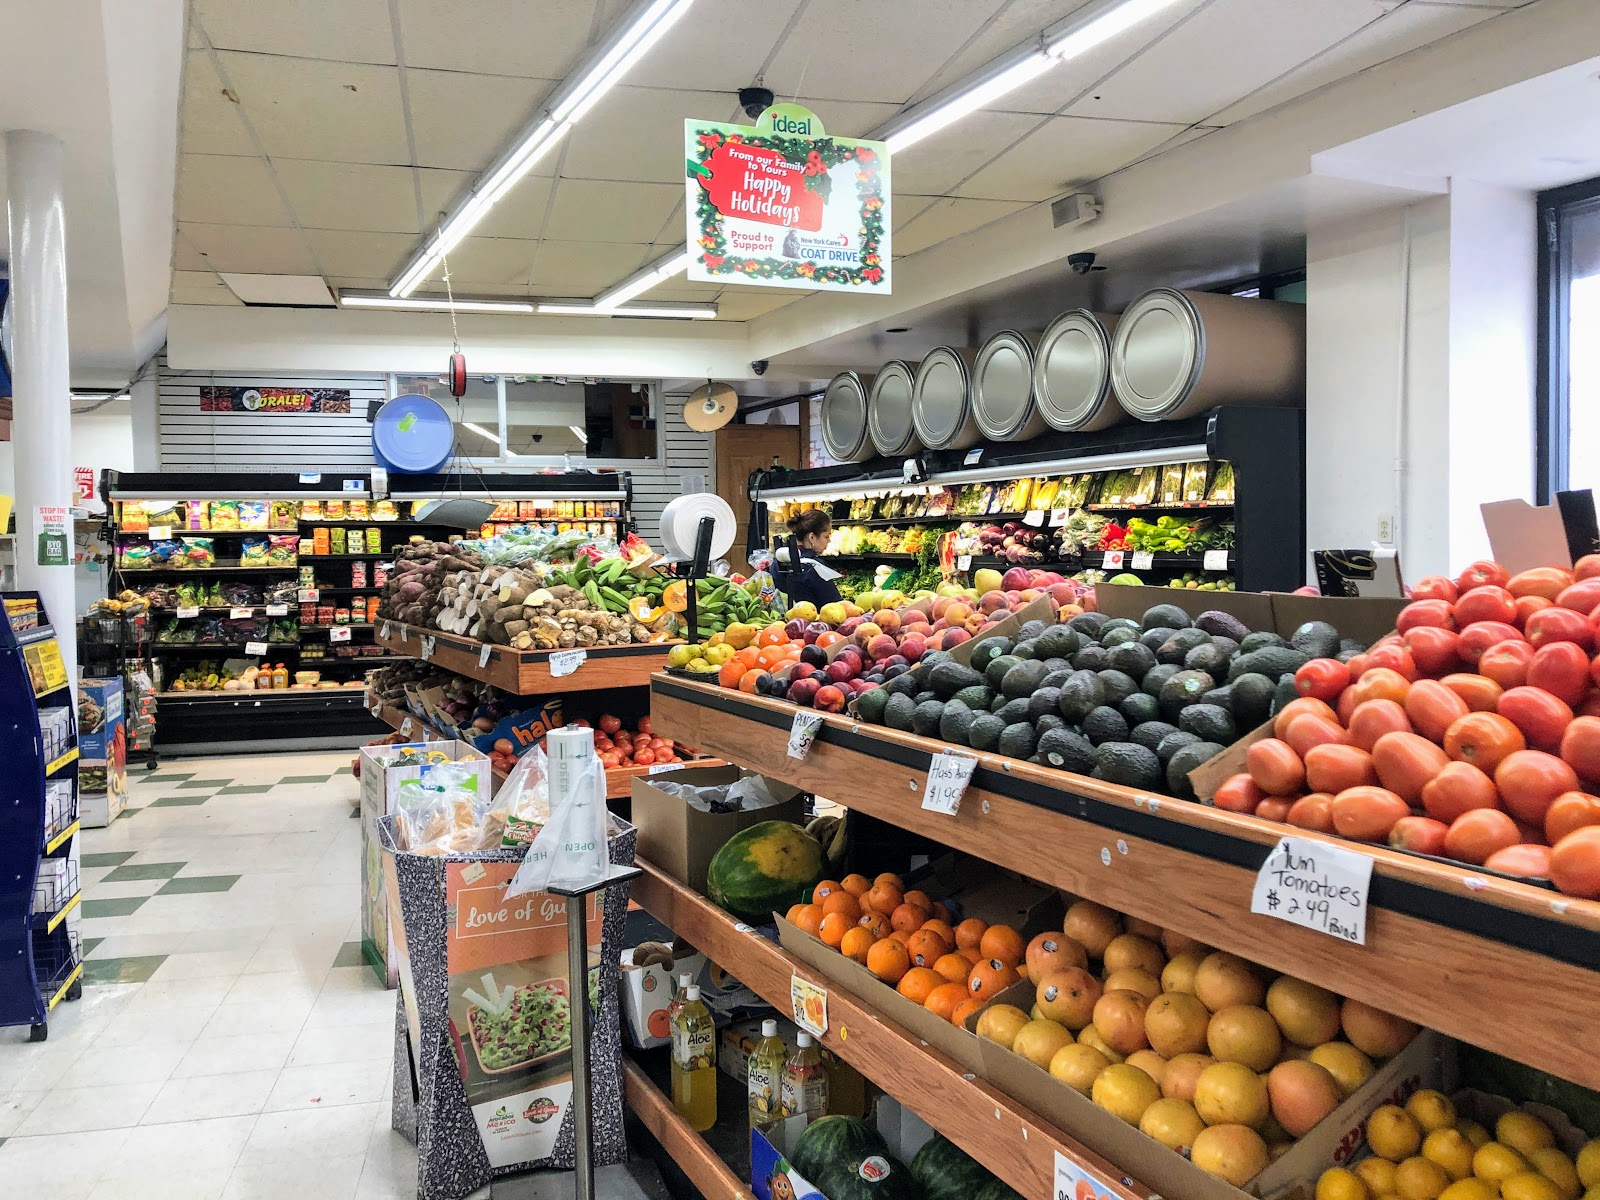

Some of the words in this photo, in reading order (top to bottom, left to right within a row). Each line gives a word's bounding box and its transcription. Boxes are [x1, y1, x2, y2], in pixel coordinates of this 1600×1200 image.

[772, 112, 811, 136] ideal
[729, 148, 754, 162] From
[756, 155, 773, 165] our
[775, 158, 807, 174] Family
[748, 161, 758, 171] to
[760, 163, 788, 177] Yours
[743, 171, 791, 204] Happy
[731, 190, 800, 226] Holidays
[731, 231, 762, 243] Proud
[764, 233, 775, 243] to
[800, 236, 812, 244] New
[813, 236, 825, 245] York
[825, 238, 841, 247] Cares
[732, 239, 773, 252] Support
[801, 248, 827, 260] COAT
[828, 249, 858, 263] DRIVE
[47, 540, 62, 548] BYO
[47, 548, 62, 556] BAG
[931, 758, 953, 781] Hass
[564, 841, 595, 852] OPEN
[1271, 870, 1361, 907] Tomatoes
[465, 902, 509, 928] Love
[514, 899, 535, 921] of
[540, 898, 568, 922] Gu
[687, 1033, 711, 1046] Aloe
[749, 1069, 770, 1085] Aloe
[487, 1119, 515, 1128] MEXICO
